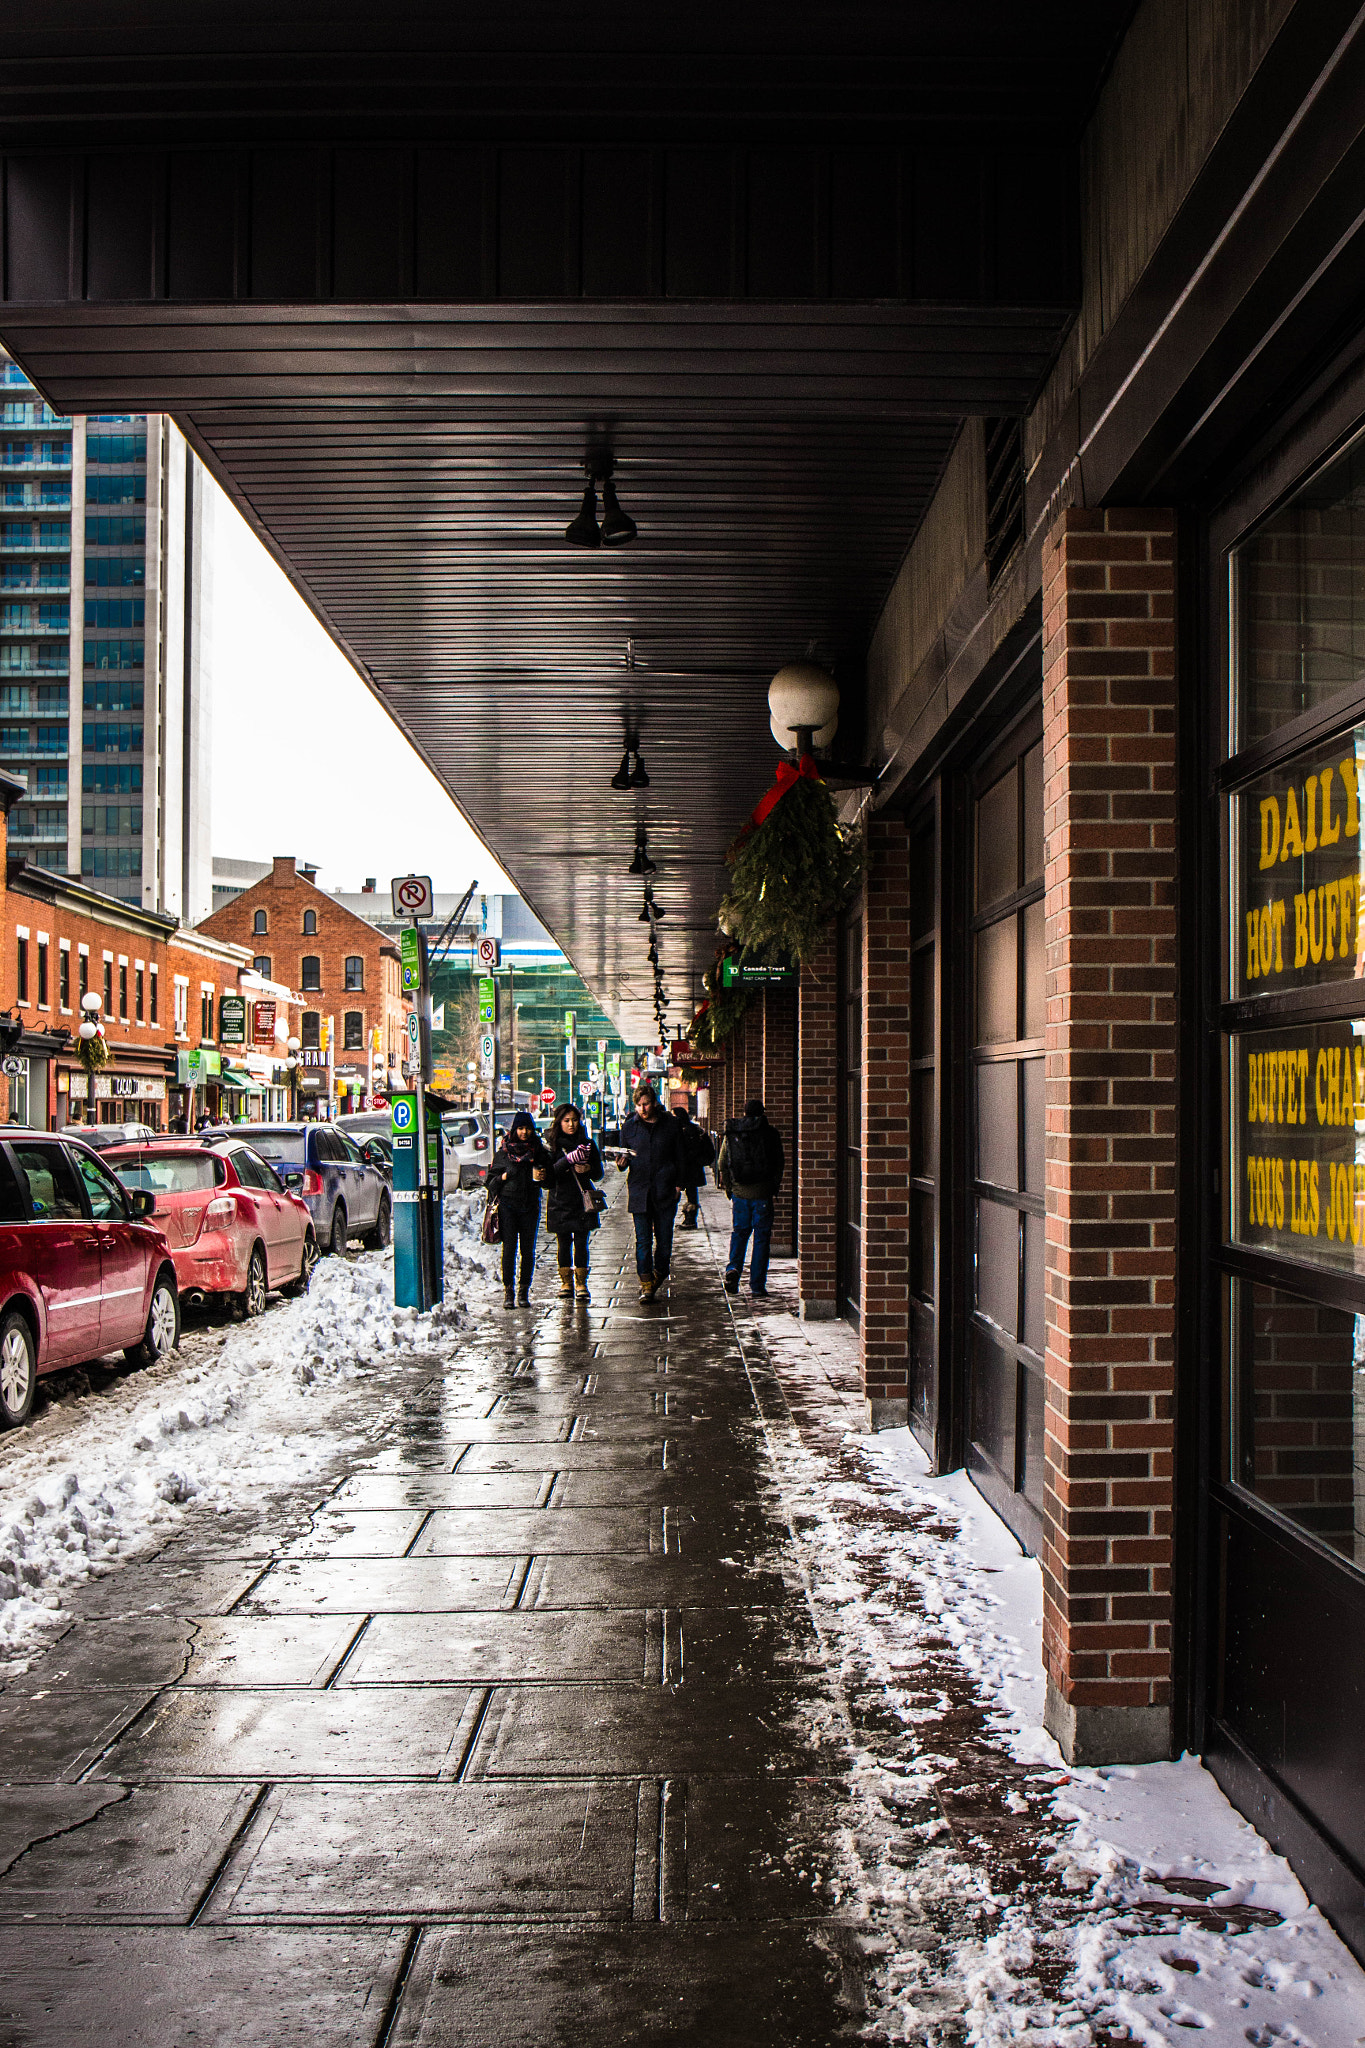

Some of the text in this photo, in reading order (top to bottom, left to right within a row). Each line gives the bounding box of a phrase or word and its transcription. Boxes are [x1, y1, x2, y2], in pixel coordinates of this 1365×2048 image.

[1259, 758, 1361, 870] DAILY
[728, 966, 739, 975] TD
[1246, 899, 1285, 980] HOT
[115, 1078, 133, 1096] CACAO
[1248, 1048, 1309, 1125] BUFFET
[1247, 1156, 1365, 1247] TOUS LES JOU
